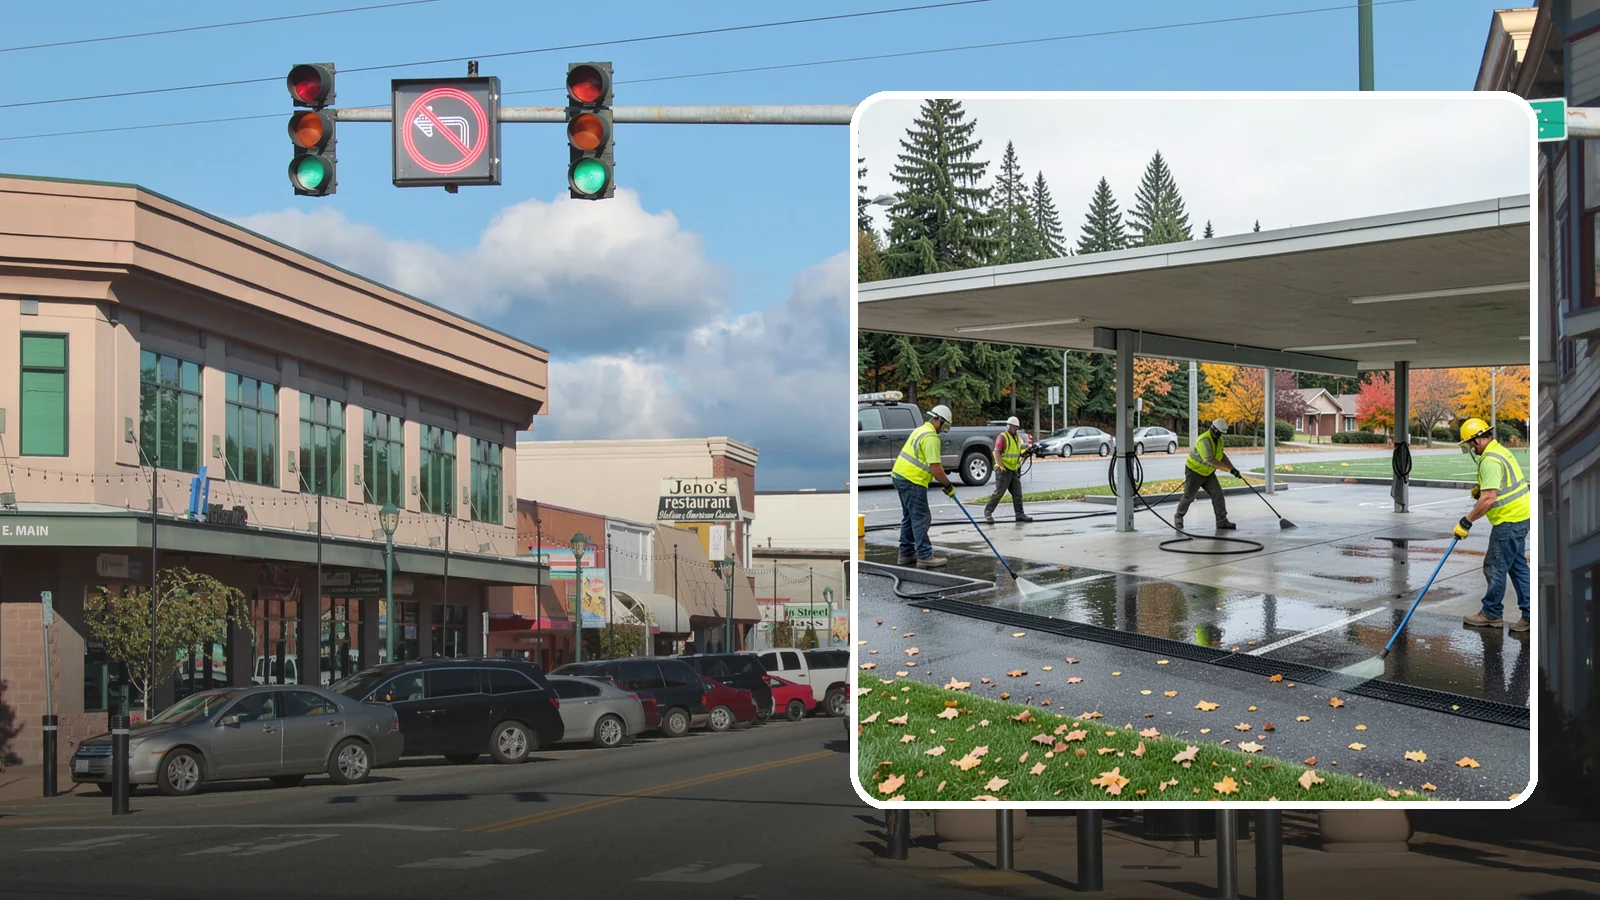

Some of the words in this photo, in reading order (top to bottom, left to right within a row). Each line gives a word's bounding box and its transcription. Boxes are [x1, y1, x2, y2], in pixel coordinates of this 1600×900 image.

[669, 480, 727, 494] Jeno's
[665, 496, 731, 509] restaurant
[658, 510, 681, 519] Italian
[686, 510, 714, 519] American
[715, 509, 737, 519] Cuisine
[2, 525, 13, 536] E.
[15, 525, 49, 536] MAIN
[797, 607, 828, 617] Street
